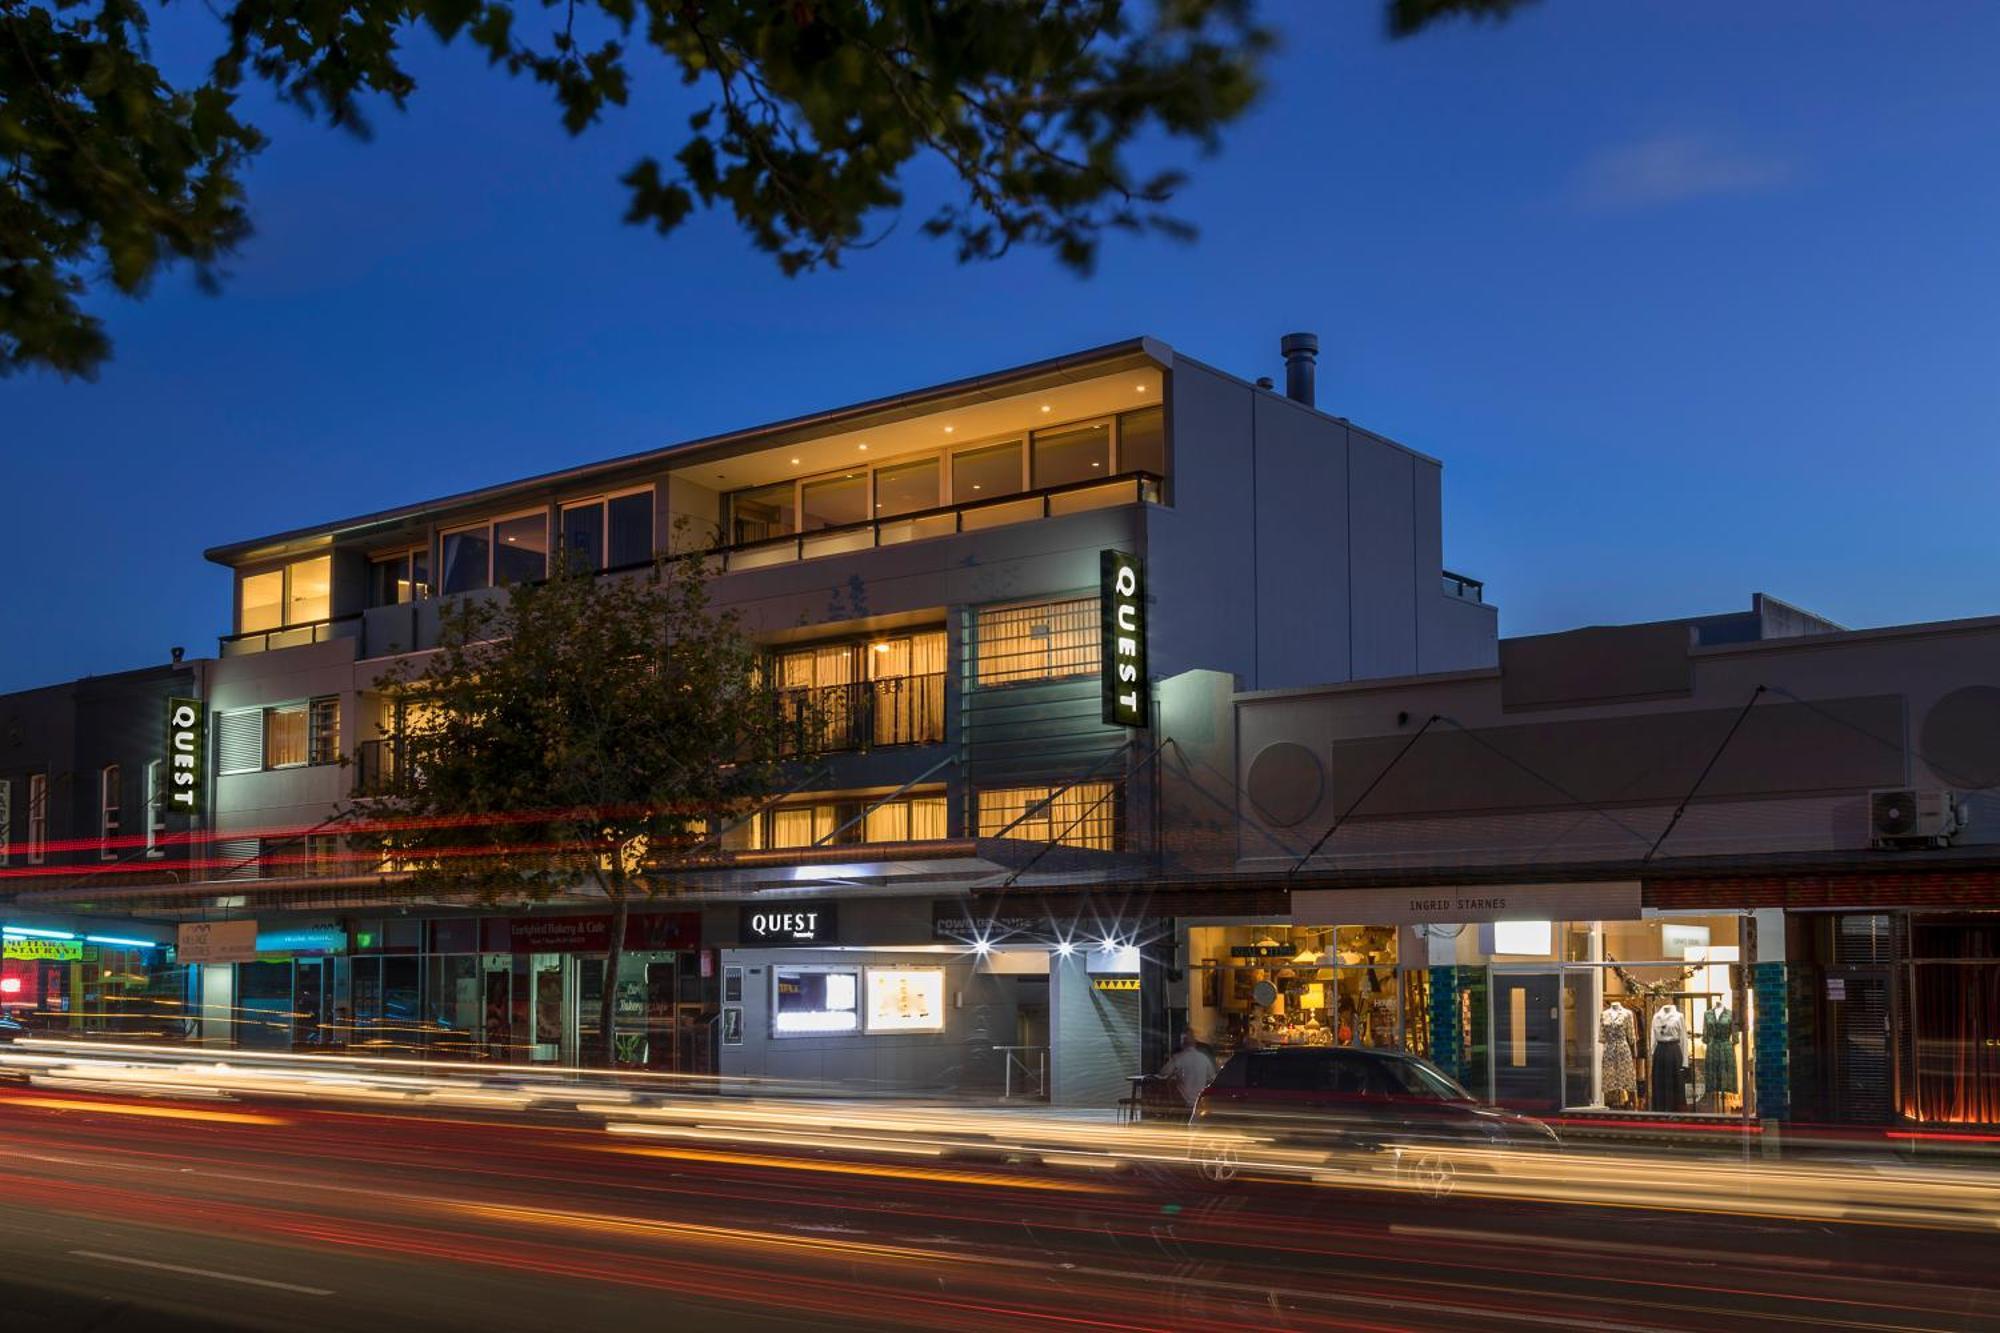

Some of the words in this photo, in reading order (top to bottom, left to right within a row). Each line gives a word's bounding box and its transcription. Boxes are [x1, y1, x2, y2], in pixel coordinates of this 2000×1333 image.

[1116, 566, 1137, 713] QUEST
[172, 706, 195, 806] QUEST
[752, 913, 818, 935] QUEST
[1409, 900, 1450, 911] INGRID
[1456, 898, 1506, 910] STARNES
